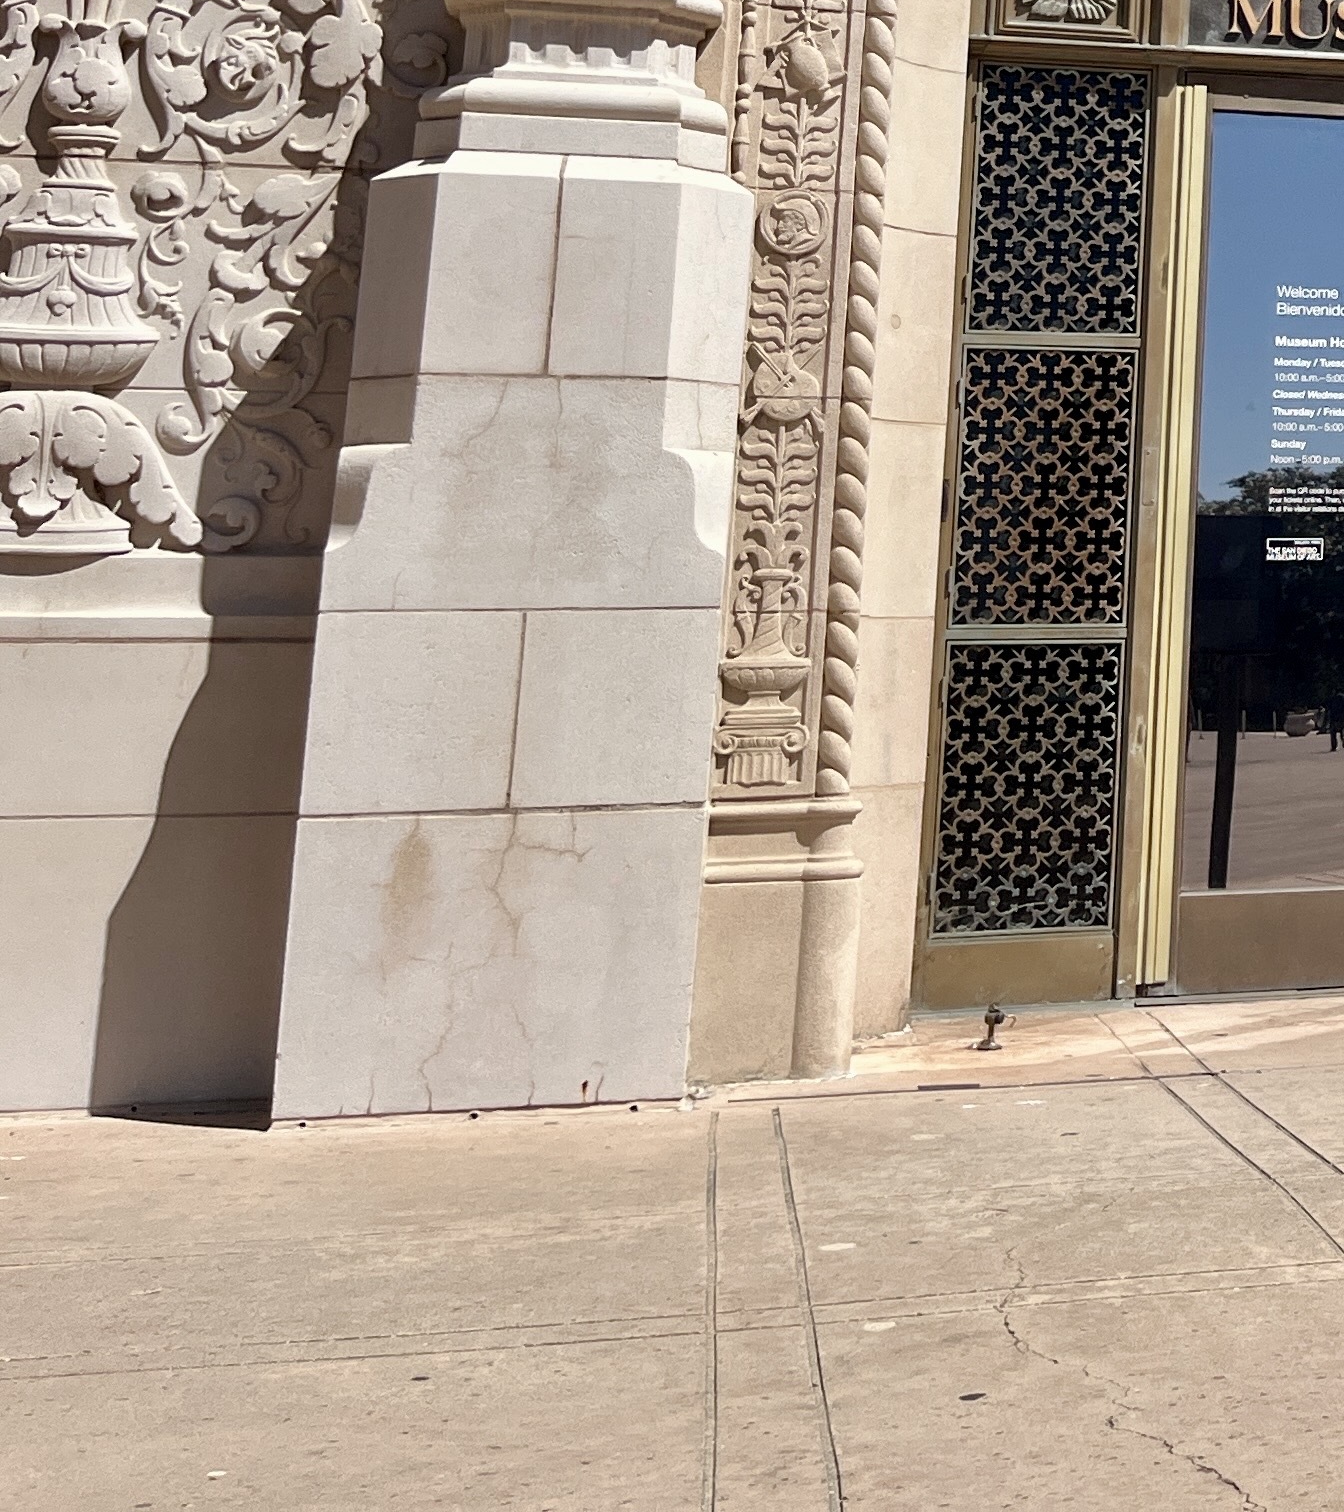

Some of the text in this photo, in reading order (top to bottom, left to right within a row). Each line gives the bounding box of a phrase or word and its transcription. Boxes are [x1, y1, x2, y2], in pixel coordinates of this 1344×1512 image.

[1277, 285, 1339, 300] Welcome
[1275, 336, 1327, 348] Museum
[1274, 358, 1311, 368] Monday
[1274, 373, 1299, 382] 10:00
[1272, 390, 1306, 399] Closed
[1272, 406, 1315, 418] Thursday
[1272, 422, 1297, 431] 10:00
[1271, 439, 1306, 450] Sunday
[1323, 456, 1343, 465] p.m.
